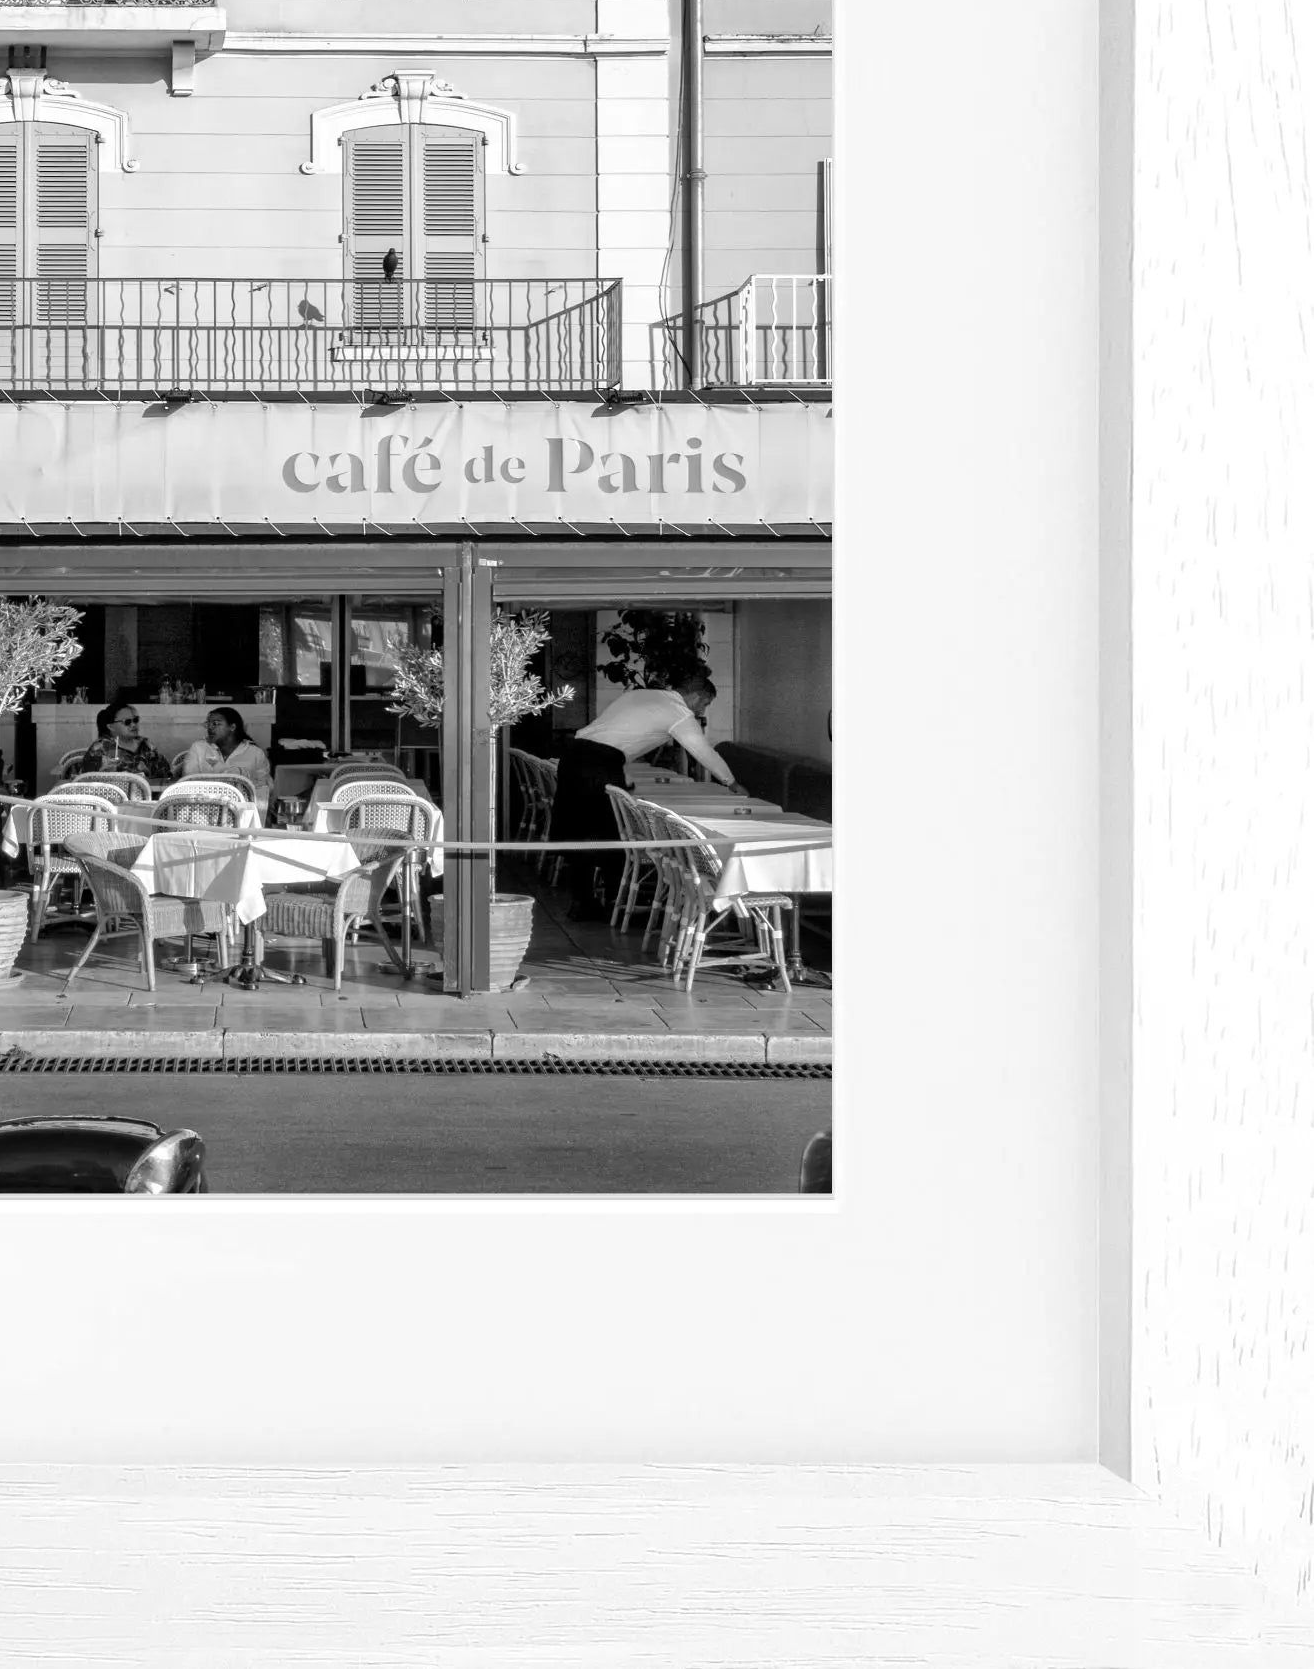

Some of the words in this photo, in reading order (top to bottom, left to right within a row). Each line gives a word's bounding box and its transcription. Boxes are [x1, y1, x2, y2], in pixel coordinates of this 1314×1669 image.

[281, 434, 443, 494] café
[464, 444, 526, 484] de
[545, 436, 747, 494] Paris
